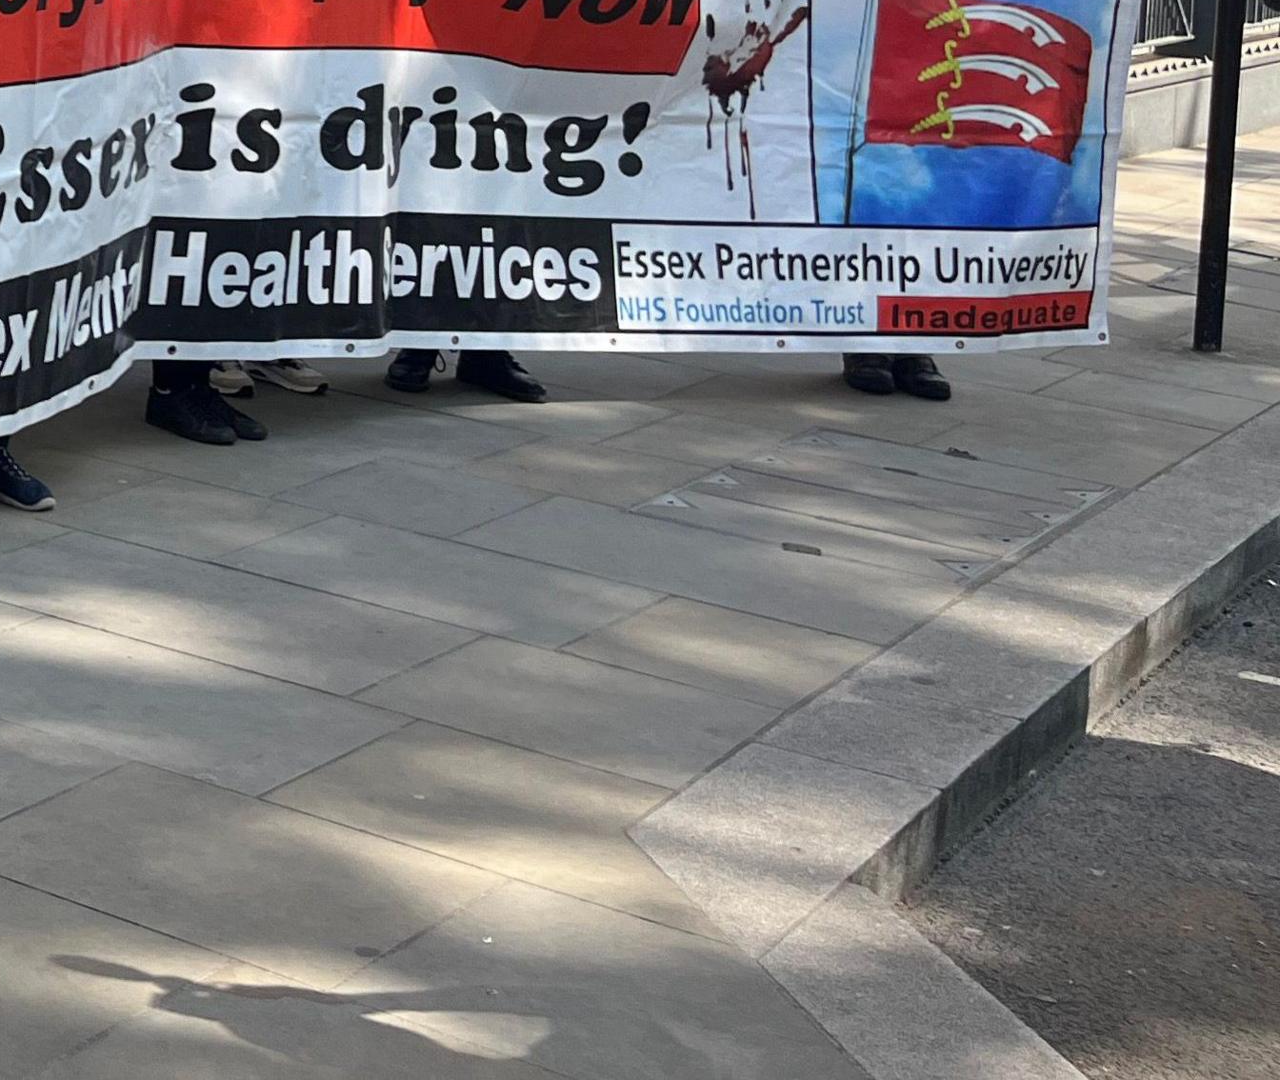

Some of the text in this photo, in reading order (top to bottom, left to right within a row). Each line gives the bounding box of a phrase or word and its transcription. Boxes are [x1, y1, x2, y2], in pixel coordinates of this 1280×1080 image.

[169, 82, 282, 173] is
[320, 83, 652, 197] dying!
[148, 229, 374, 308] Health
[616, 241, 1089, 291] Essex Partnership University
[619, 298, 865, 325] NHS Foundation Trust
[891, 303, 1077, 332] Inadequate
